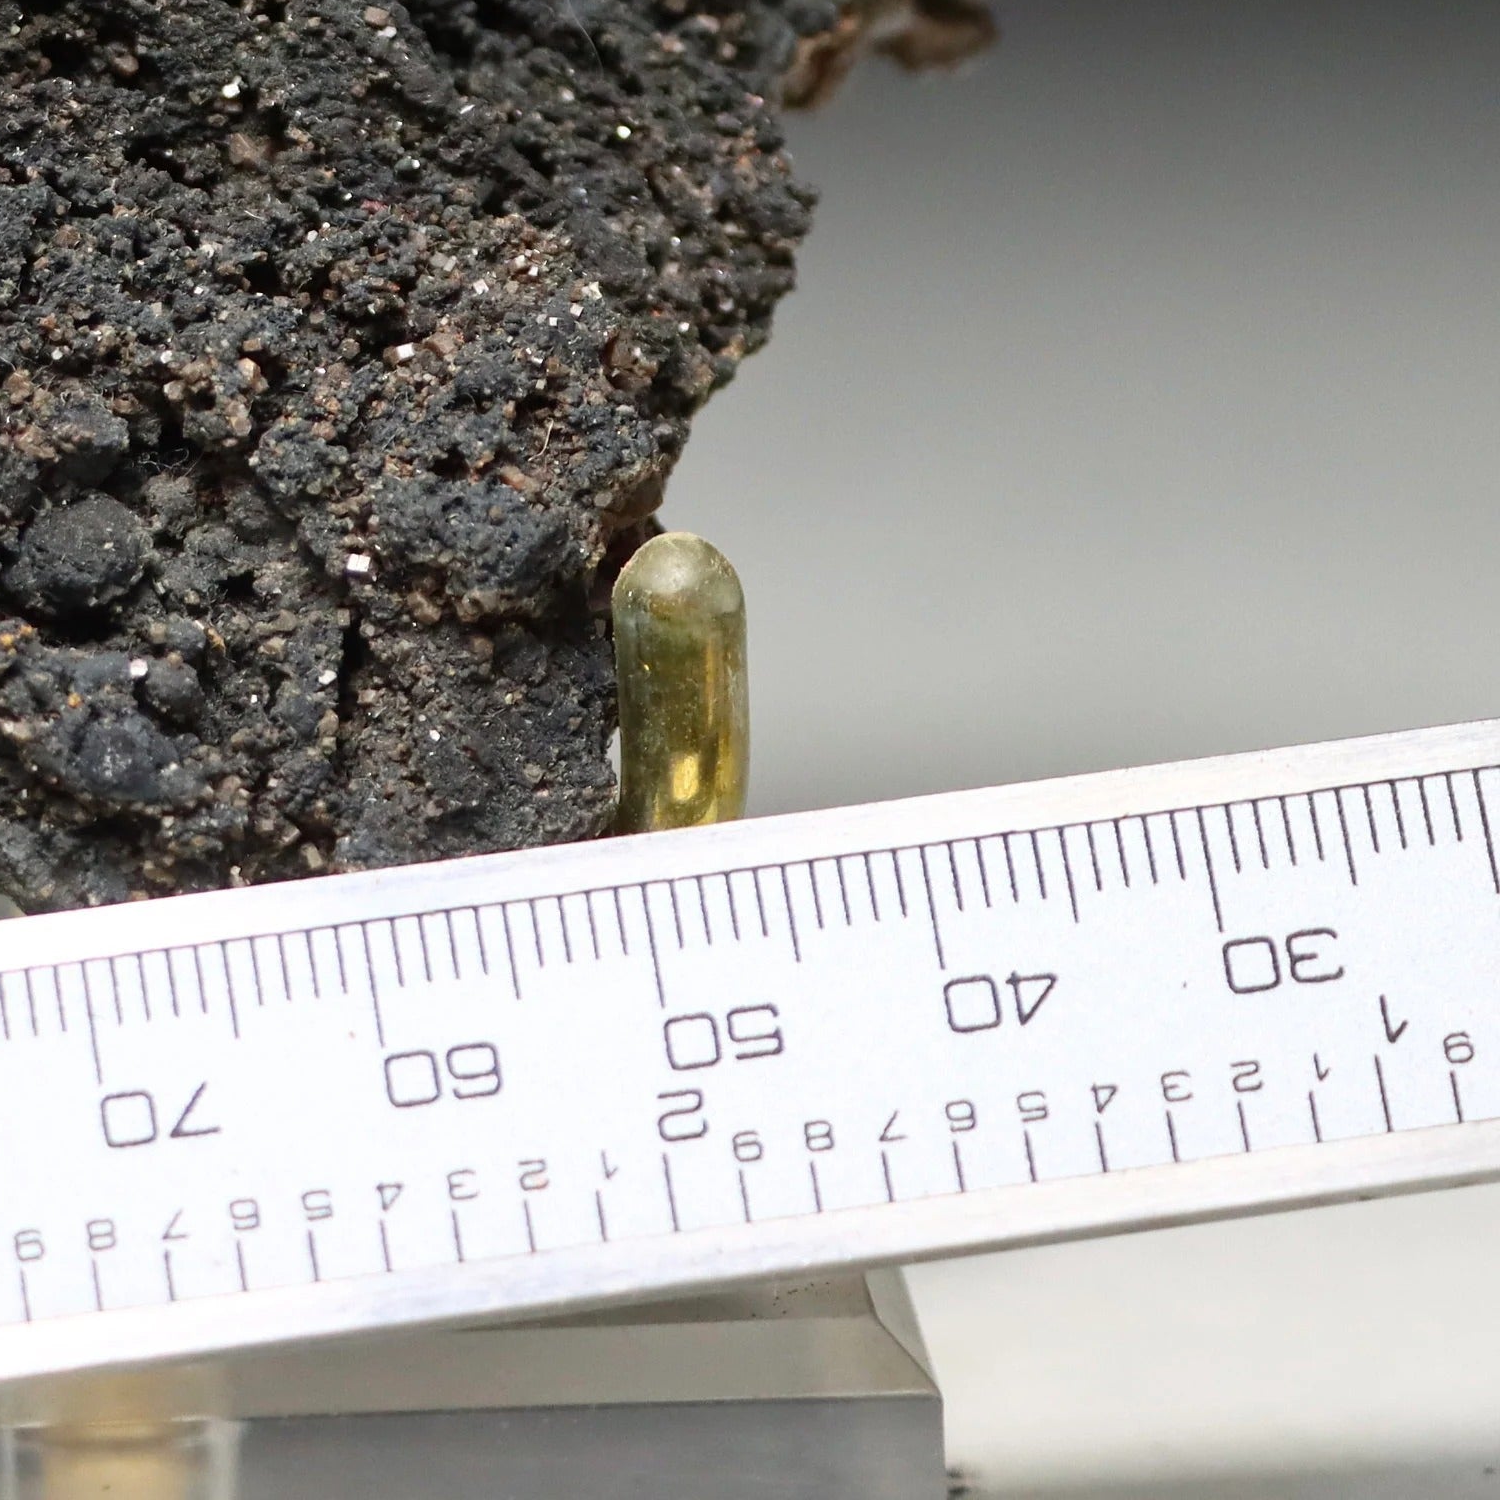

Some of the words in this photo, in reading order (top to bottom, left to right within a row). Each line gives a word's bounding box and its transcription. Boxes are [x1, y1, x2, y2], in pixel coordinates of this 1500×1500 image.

[1221, 928, 1345, 994] 30
[943, 970, 1058, 1032] 40
[1379, 994, 1409, 1044] 1
[662, 1004, 785, 1071] 50
[1442, 1031, 1475, 1065] 9
[384, 1041, 502, 1108] 60
[1230, 1060, 1262, 1092] 2
[1314, 1052, 1331, 1081] 1
[1090, 1084, 1118, 1114] 4
[1160, 1070, 1194, 1102] 3
[100, 1081, 221, 1148] 70
[656, 1088, 709, 1142] 2
[945, 1100, 977, 1132] 6
[1016, 1090, 1050, 1122] 5
[804, 1120, 835, 1152] 8
[879, 1110, 908, 1142] 7
[732, 1130, 764, 1163] 9
[518, 1158, 550, 1191] 2
[601, 1150, 620, 1181] 1
[376, 1182, 404, 1212] 4
[446, 1169, 479, 1201] 3
[229, 1199, 261, 1231] 6
[301, 1189, 333, 1221] 5
[86, 1218, 117, 1251] 8
[161, 1210, 188, 1241] 7
[14, 1229, 45, 1262] 9
